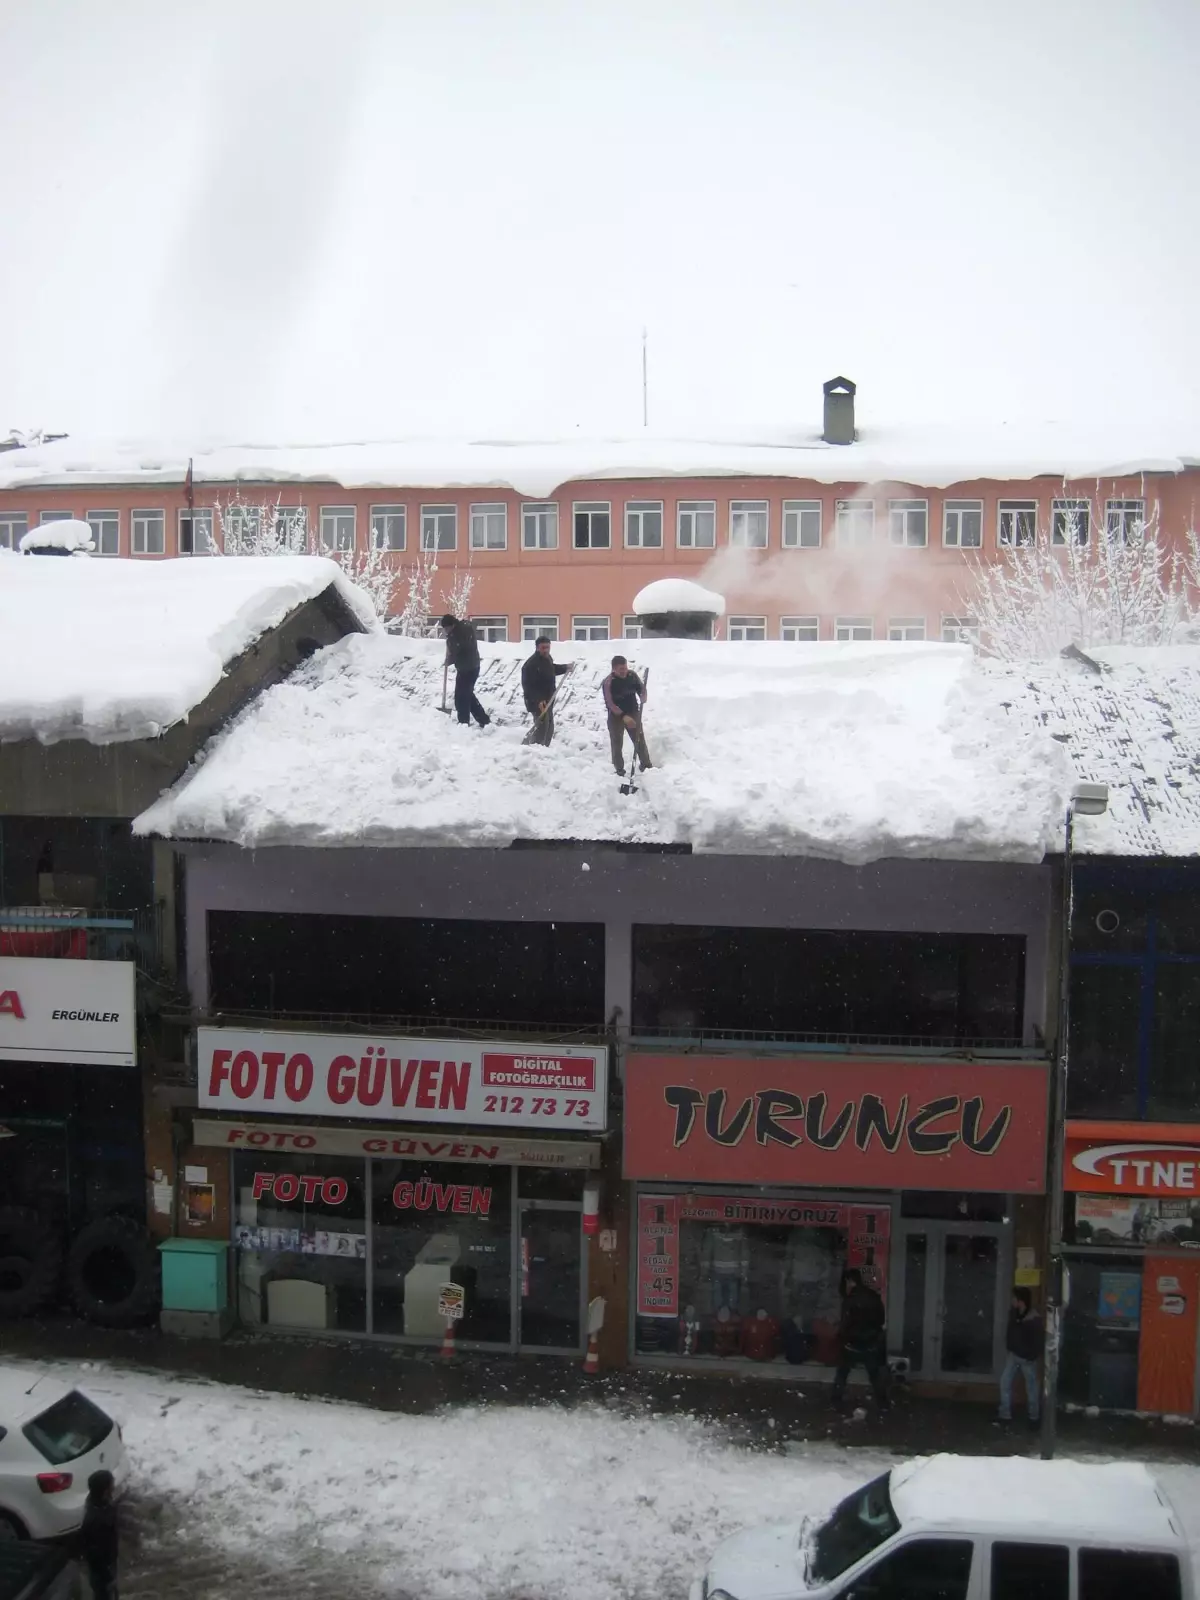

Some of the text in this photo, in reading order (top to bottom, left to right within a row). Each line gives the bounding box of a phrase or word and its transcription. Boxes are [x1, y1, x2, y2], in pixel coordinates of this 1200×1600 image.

[52, 1008, 119, 1022] ERGÜNLER
[514, 1056, 563, 1071] DİGİTAL
[208, 1047, 472, 1111] FOTO GÜVEN
[489, 1071, 587, 1088] FOTOĞRAFÇILIK
[483, 1095, 590, 1117] 212 73 73
[664, 1085, 1011, 1156] TURUNCU
[227, 1129, 317, 1148] FOTO
[362, 1138, 499, 1160] GÜVEN
[1108, 1159, 1200, 1189] TTNE
[252, 1171, 492, 1215] FOTO GÜVEN
